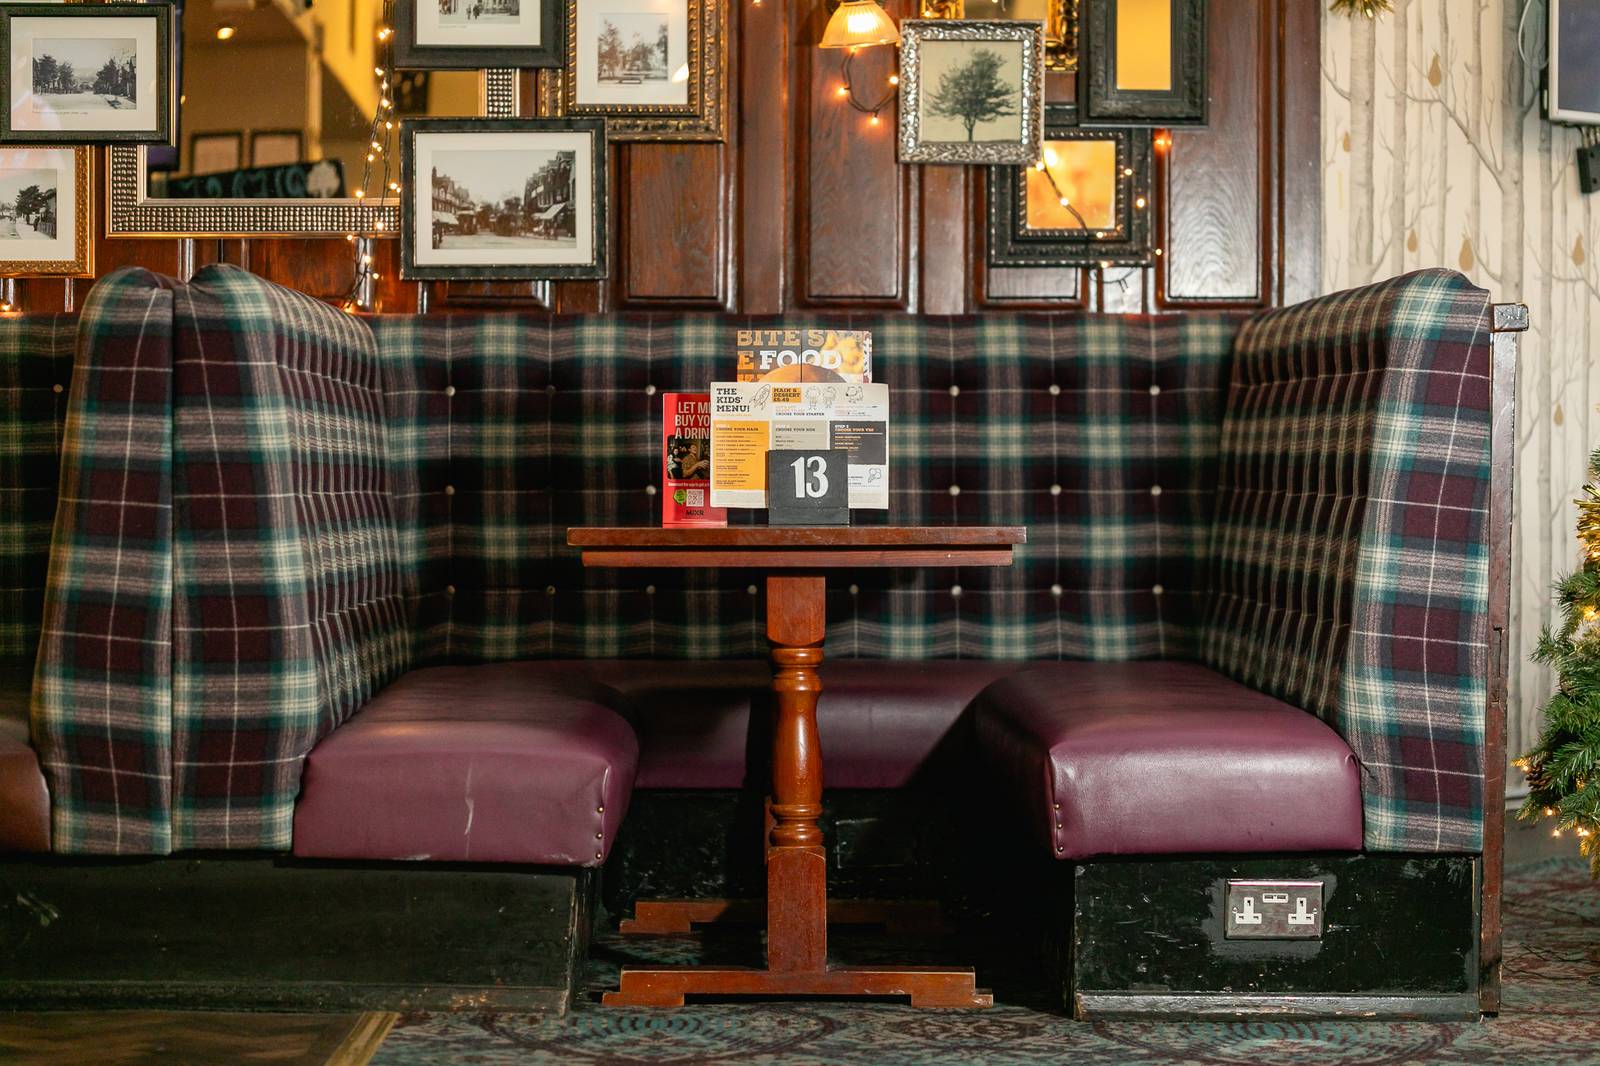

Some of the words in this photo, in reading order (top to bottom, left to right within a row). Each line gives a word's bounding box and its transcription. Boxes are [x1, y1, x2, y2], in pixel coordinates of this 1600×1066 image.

[737, 330, 800, 347] BITE
[760, 350, 842, 370] FOOD
[678, 402, 696, 413] LET
[675, 415, 696, 427] BUY
[697, 415, 710, 427] YO
[675, 428, 683, 439] A
[684, 428, 710, 439] DRIN
[790, 456, 829, 498] 13
